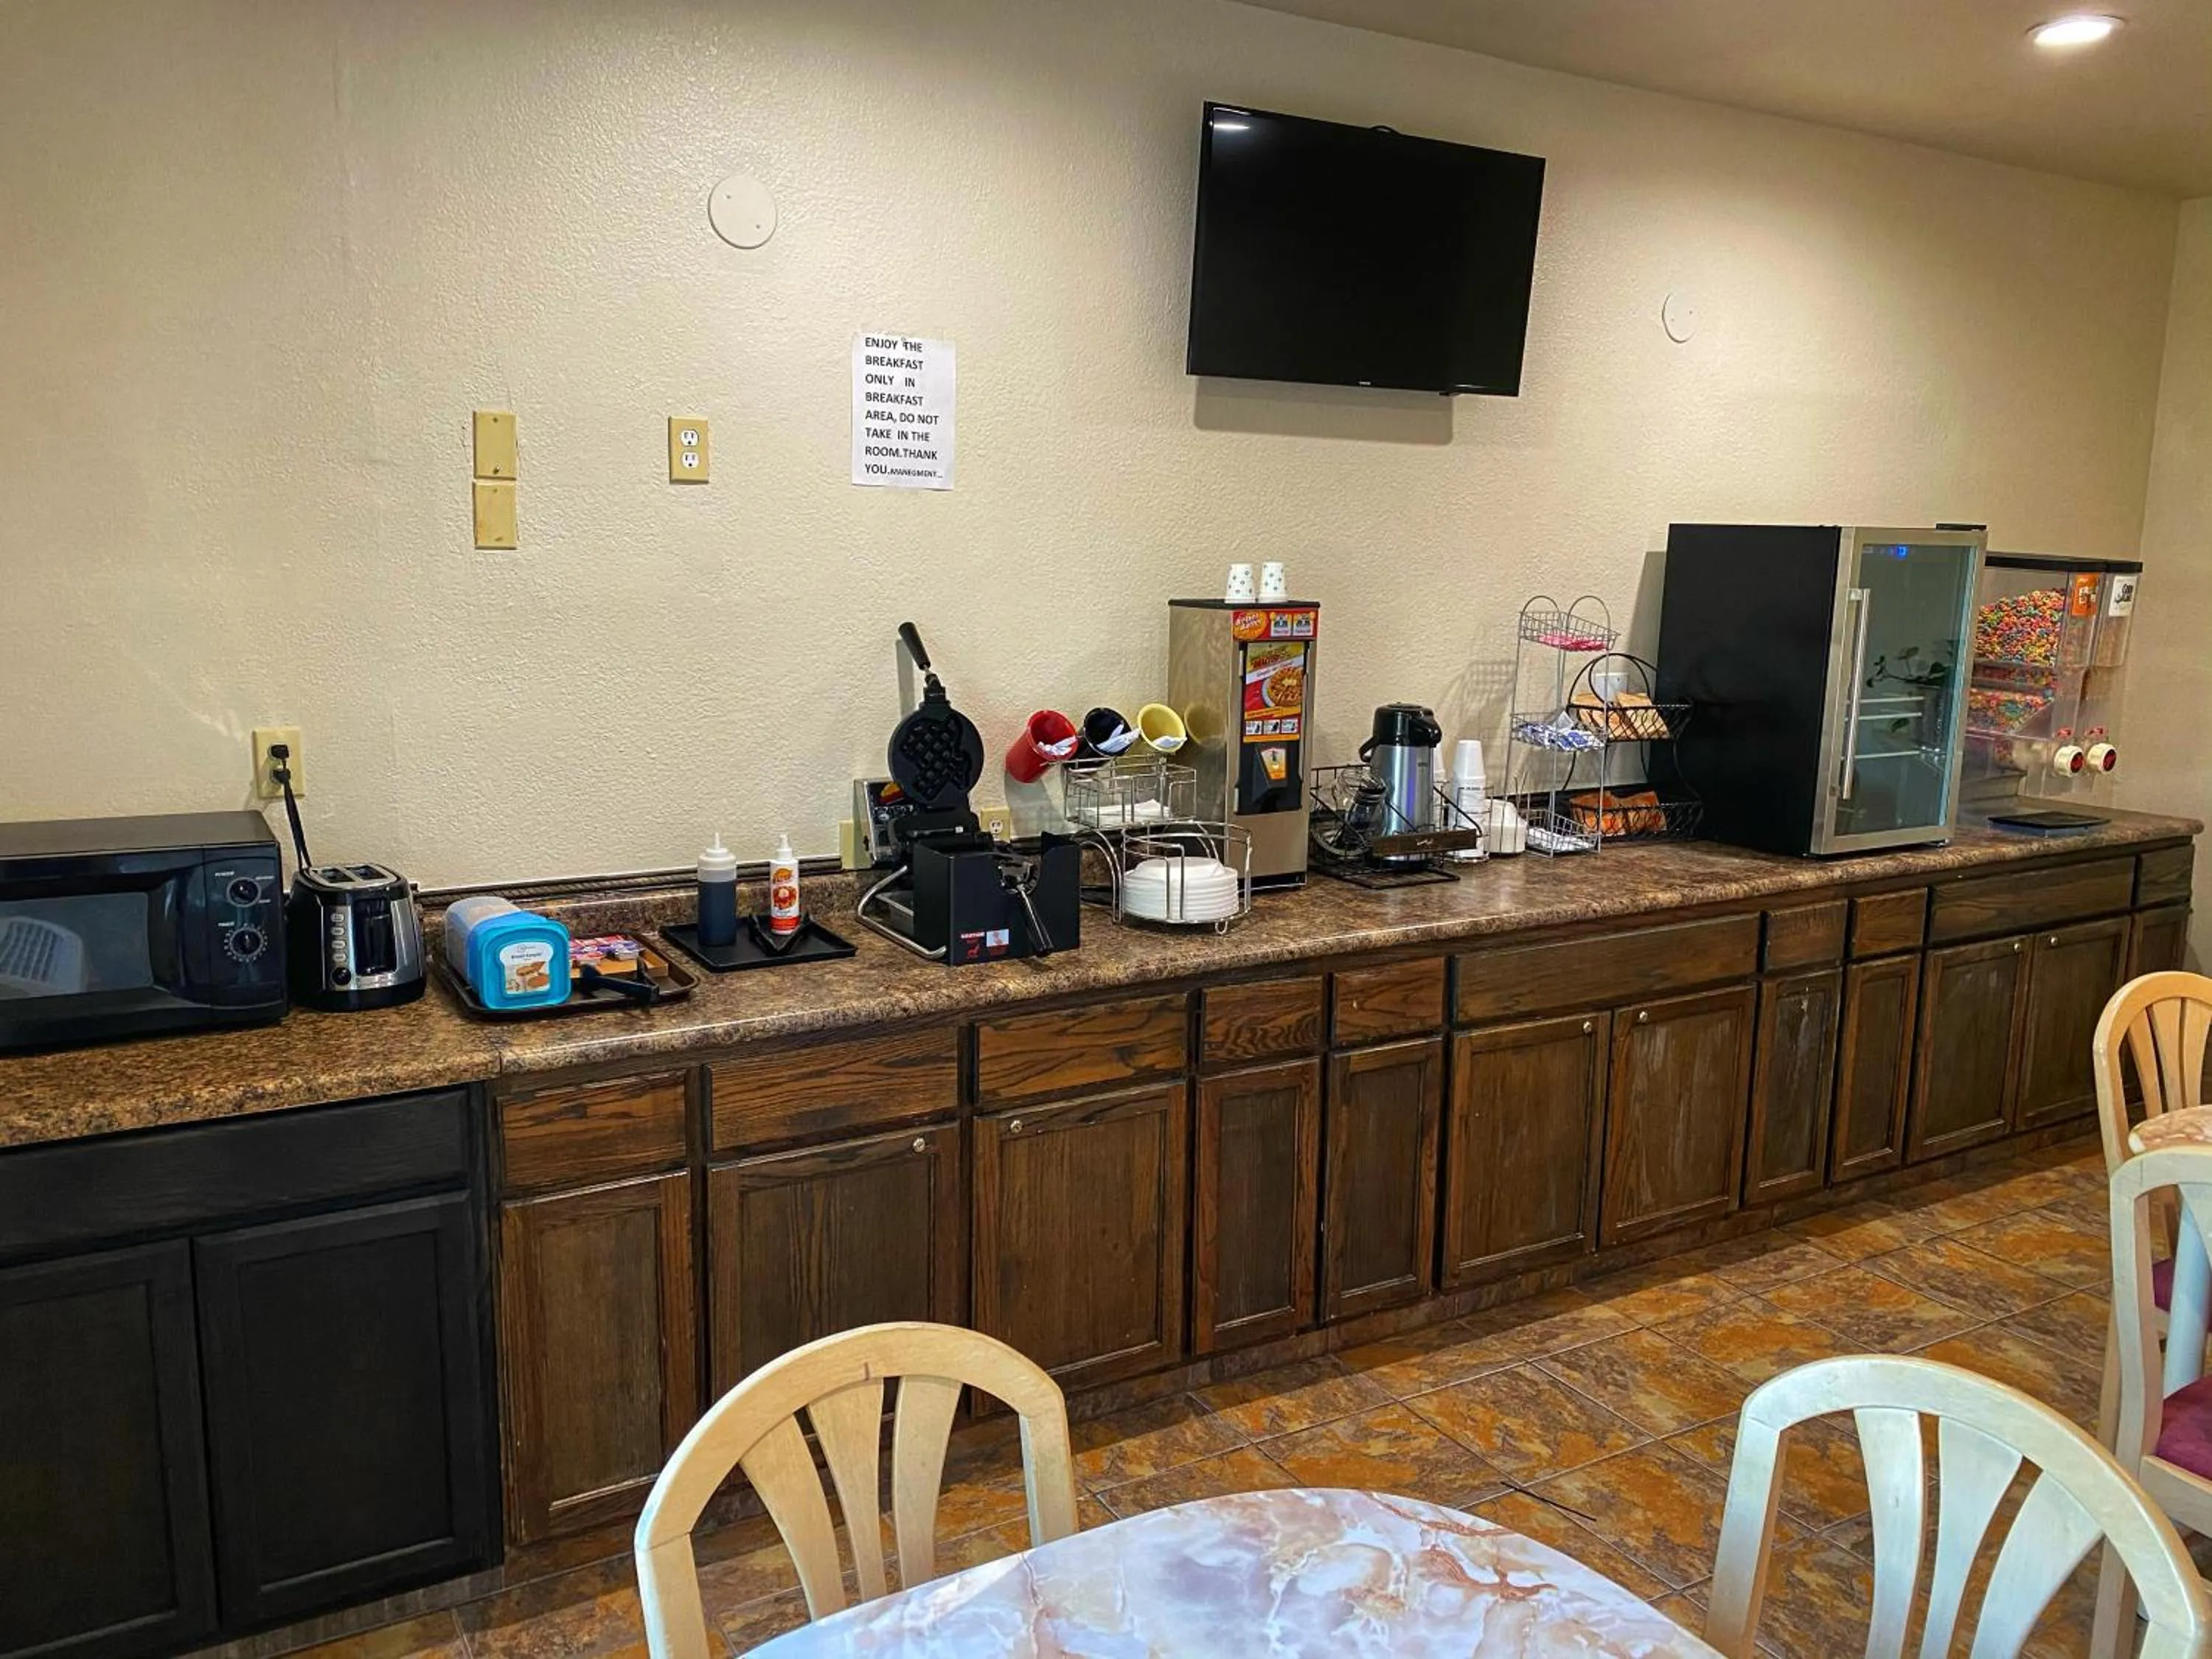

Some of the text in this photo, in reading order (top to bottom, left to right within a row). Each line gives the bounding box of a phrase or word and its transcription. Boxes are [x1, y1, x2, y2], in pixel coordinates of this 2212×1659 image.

[865, 337, 923, 352] ENJOY THE
[865, 355, 923, 370] BREAKFAST
[865, 373, 915, 387] ONLY IN
[865, 392, 923, 406] BREAKFAST
[865, 410, 939, 425] AREA, DO NOT
[865, 427, 931, 442] TAKE IN THE
